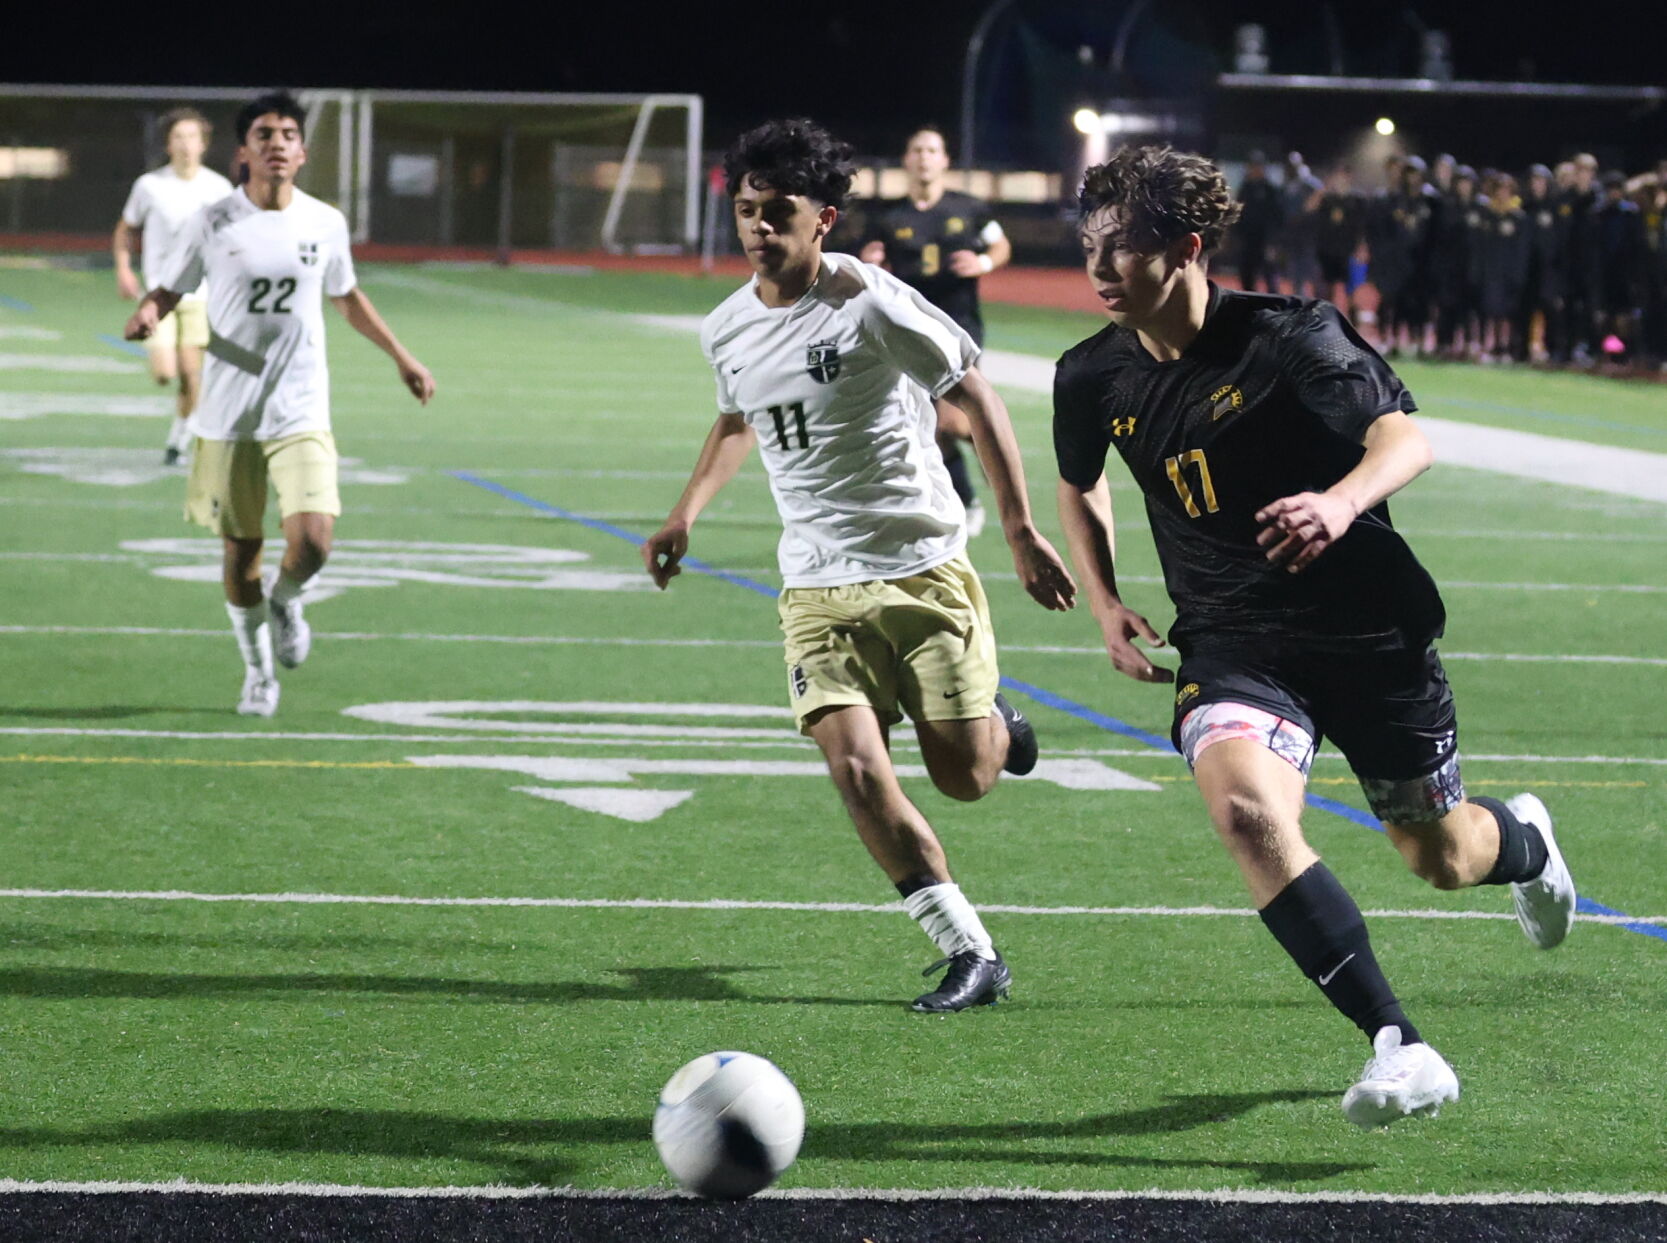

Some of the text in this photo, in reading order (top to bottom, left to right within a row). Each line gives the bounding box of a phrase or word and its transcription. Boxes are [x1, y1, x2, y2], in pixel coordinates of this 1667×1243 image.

[247, 277, 297, 314] 22
[767, 402, 809, 451] 11
[1165, 449, 1220, 518] 17
